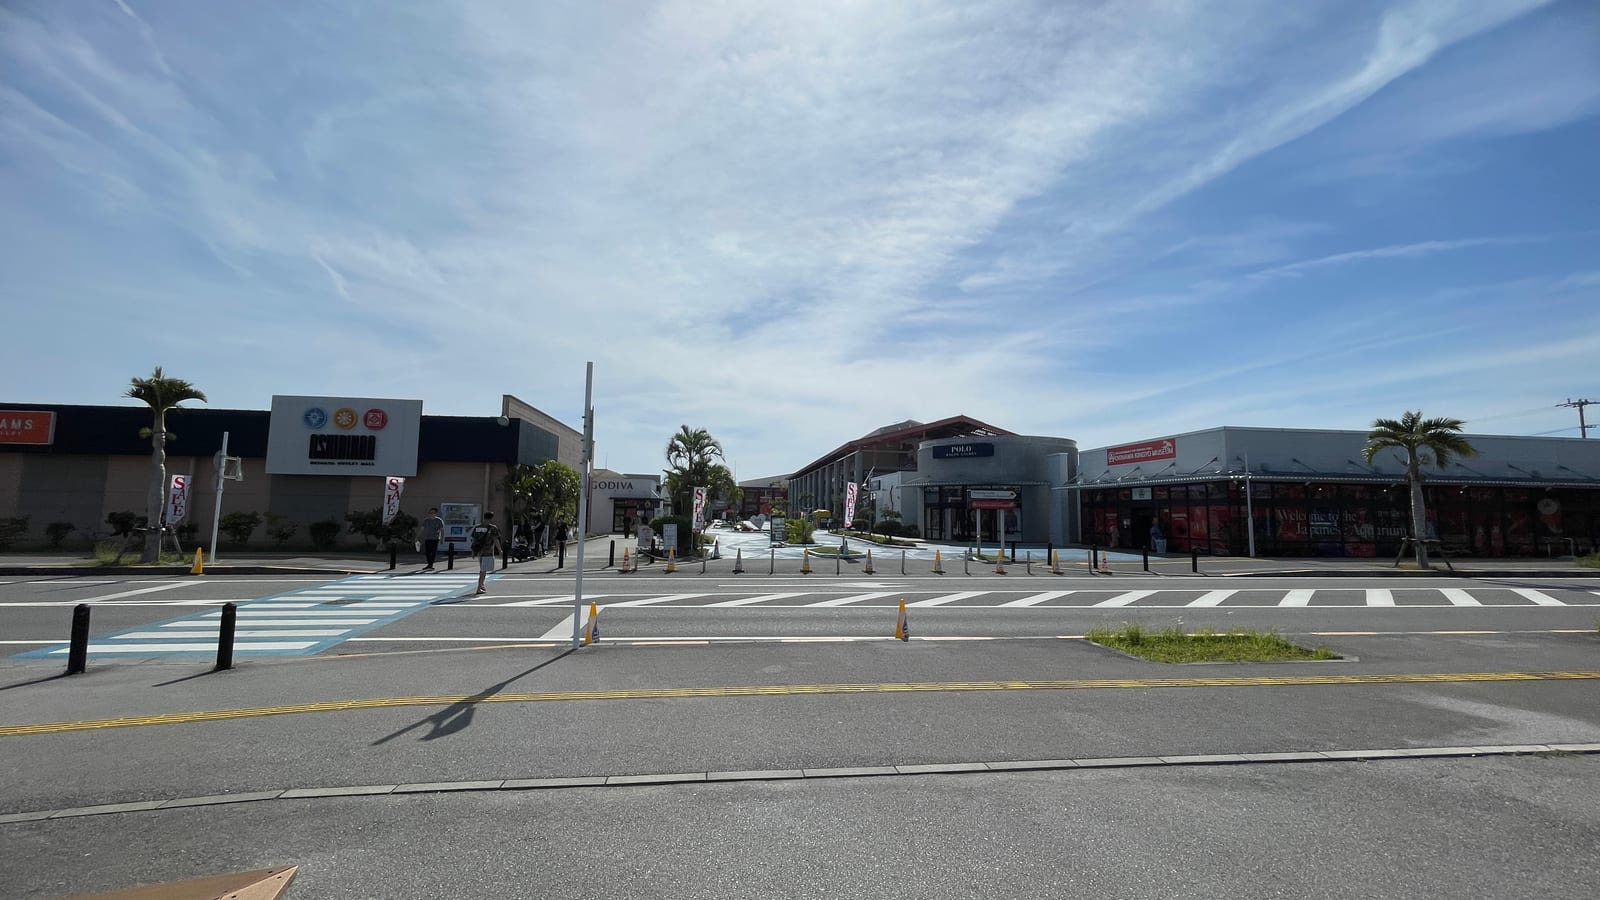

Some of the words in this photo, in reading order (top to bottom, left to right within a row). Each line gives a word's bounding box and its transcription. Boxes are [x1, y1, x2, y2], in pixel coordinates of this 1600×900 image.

[951, 445, 972, 453] POLO
[173, 476, 185, 517] SALE
[387, 478, 400, 516] SALE
